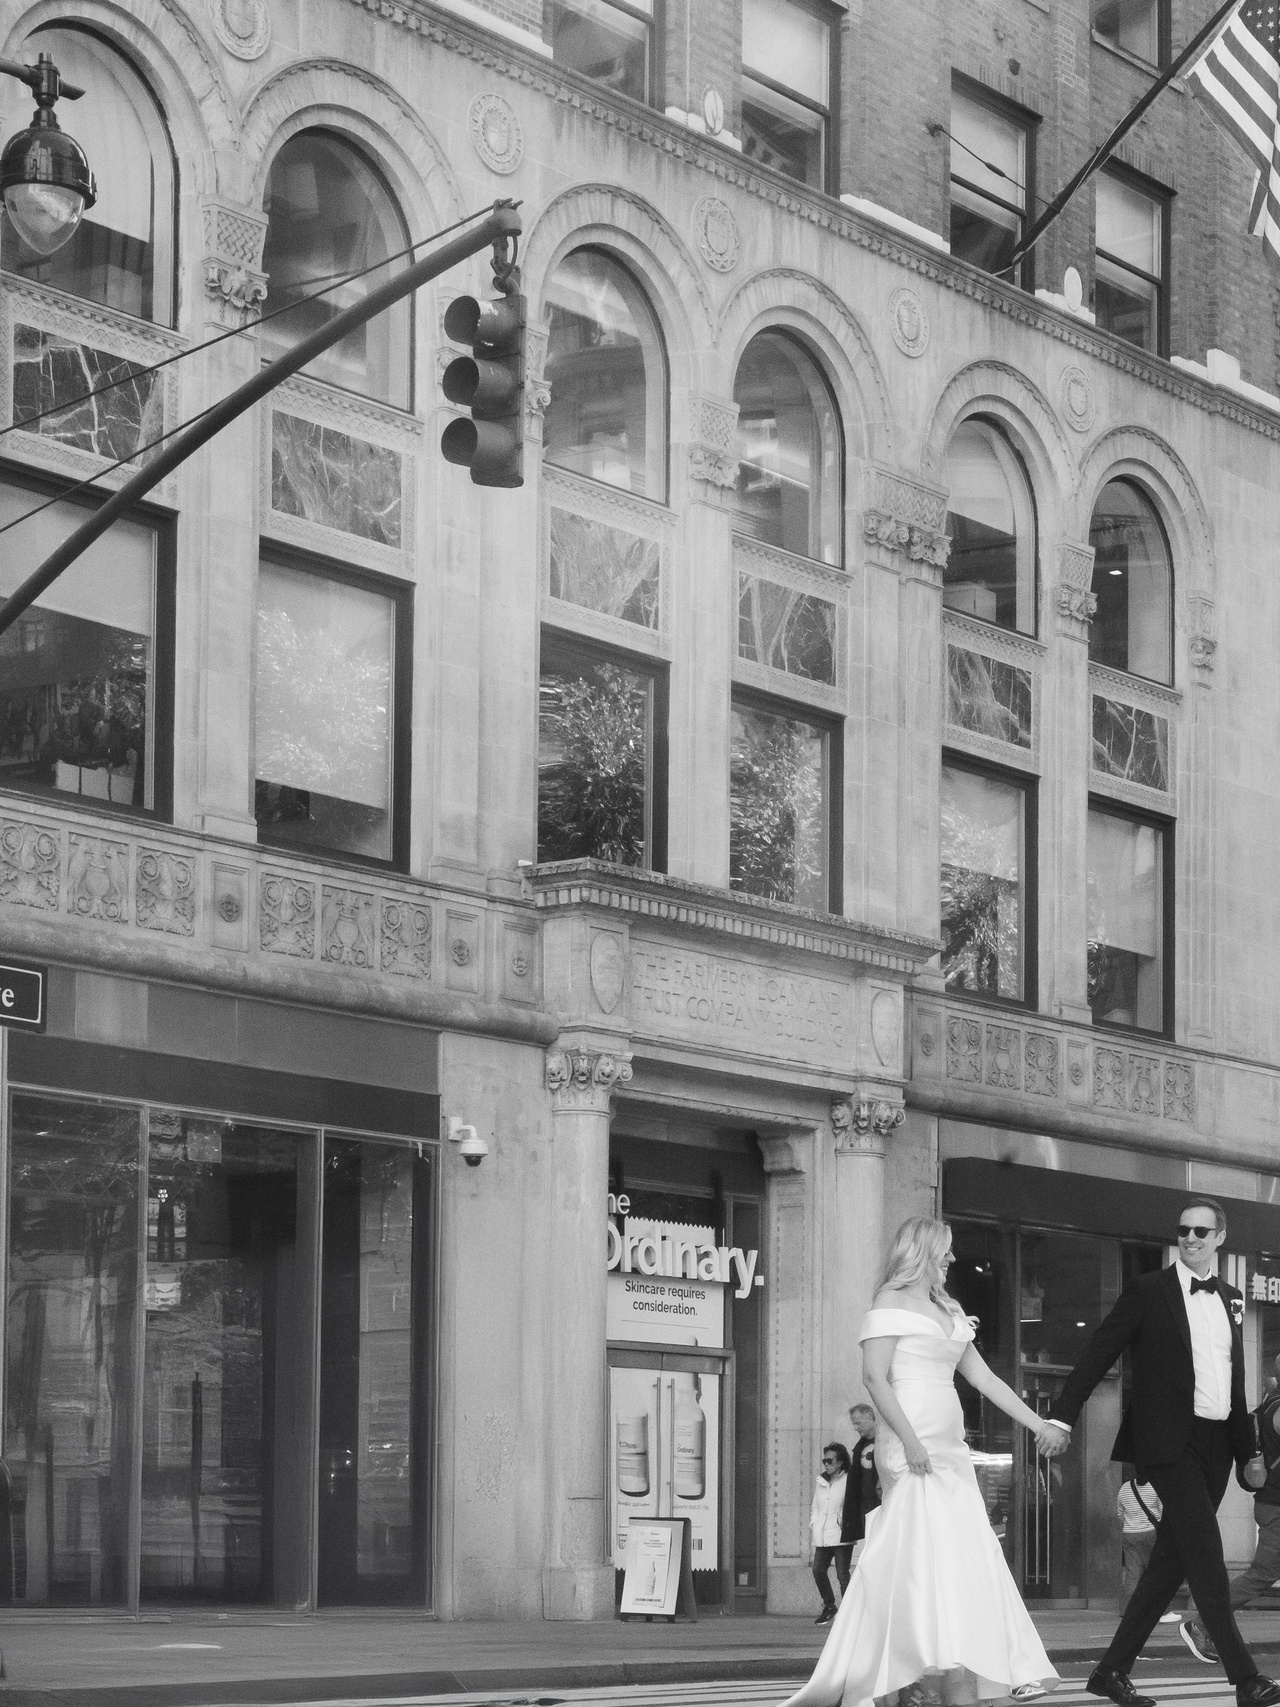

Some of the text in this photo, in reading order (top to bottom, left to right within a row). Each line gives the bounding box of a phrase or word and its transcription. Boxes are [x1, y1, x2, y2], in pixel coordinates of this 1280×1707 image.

[635, 951, 669, 982] THE
[758, 977, 803, 1007] LOAN
[806, 986, 842, 1016] AND
[0, 986, 15, 1008] e
[633, 985, 845, 1048] TRUST COMPANY BUILDING
[625, 1279, 706, 1301] Skincare requires
[632, 1300, 698, 1316] consideration.
